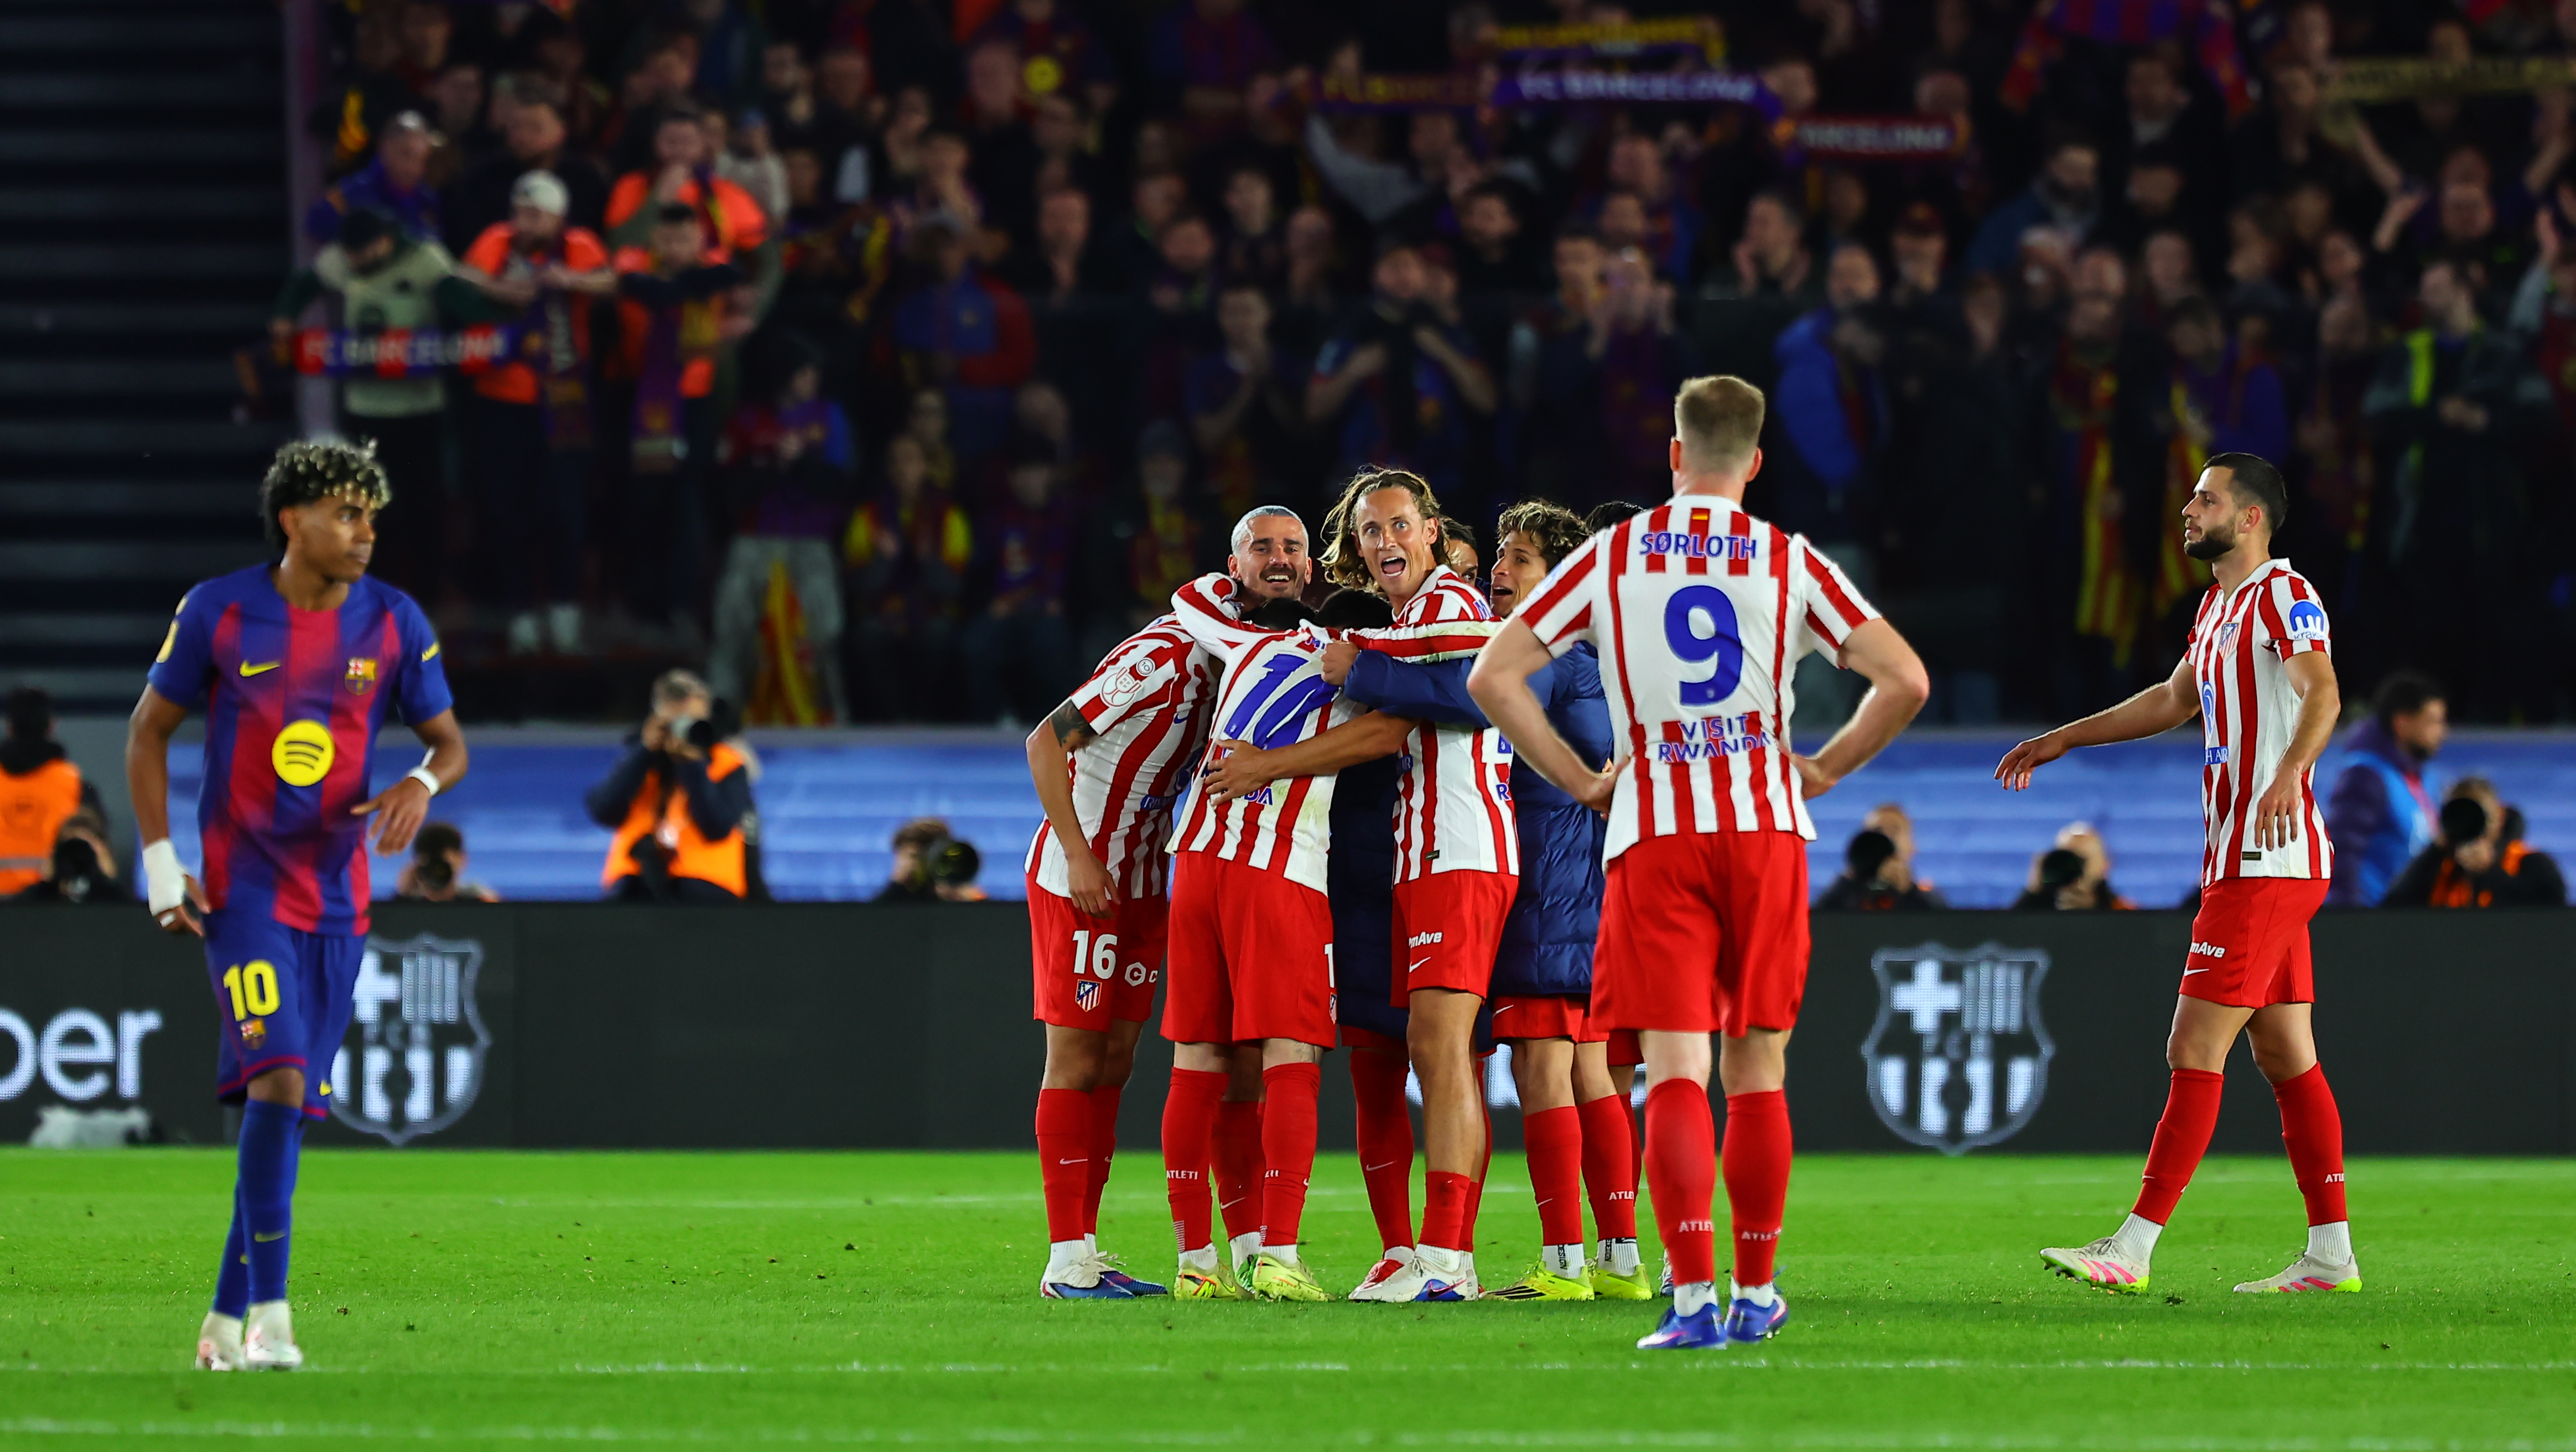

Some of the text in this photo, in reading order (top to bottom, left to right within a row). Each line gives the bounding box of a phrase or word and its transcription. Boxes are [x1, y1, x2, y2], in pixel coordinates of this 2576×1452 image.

[1564, 72, 1757, 102] BARCELONA
[342, 330, 509, 366] BARCELONA
[1639, 532, 1757, 559] SØRLOTH
[1664, 585, 1743, 706] 9
[1679, 715, 1748, 740] VISIT
[1659, 731, 1770, 763] RWANDA
[2215, 748, 2227, 762] AIR
[1072, 930, 1118, 979] 16
[1408, 931, 1442, 948] mAve
[222, 960, 281, 1021] 10
[1166, 1170, 1198, 1180] ATLETI
